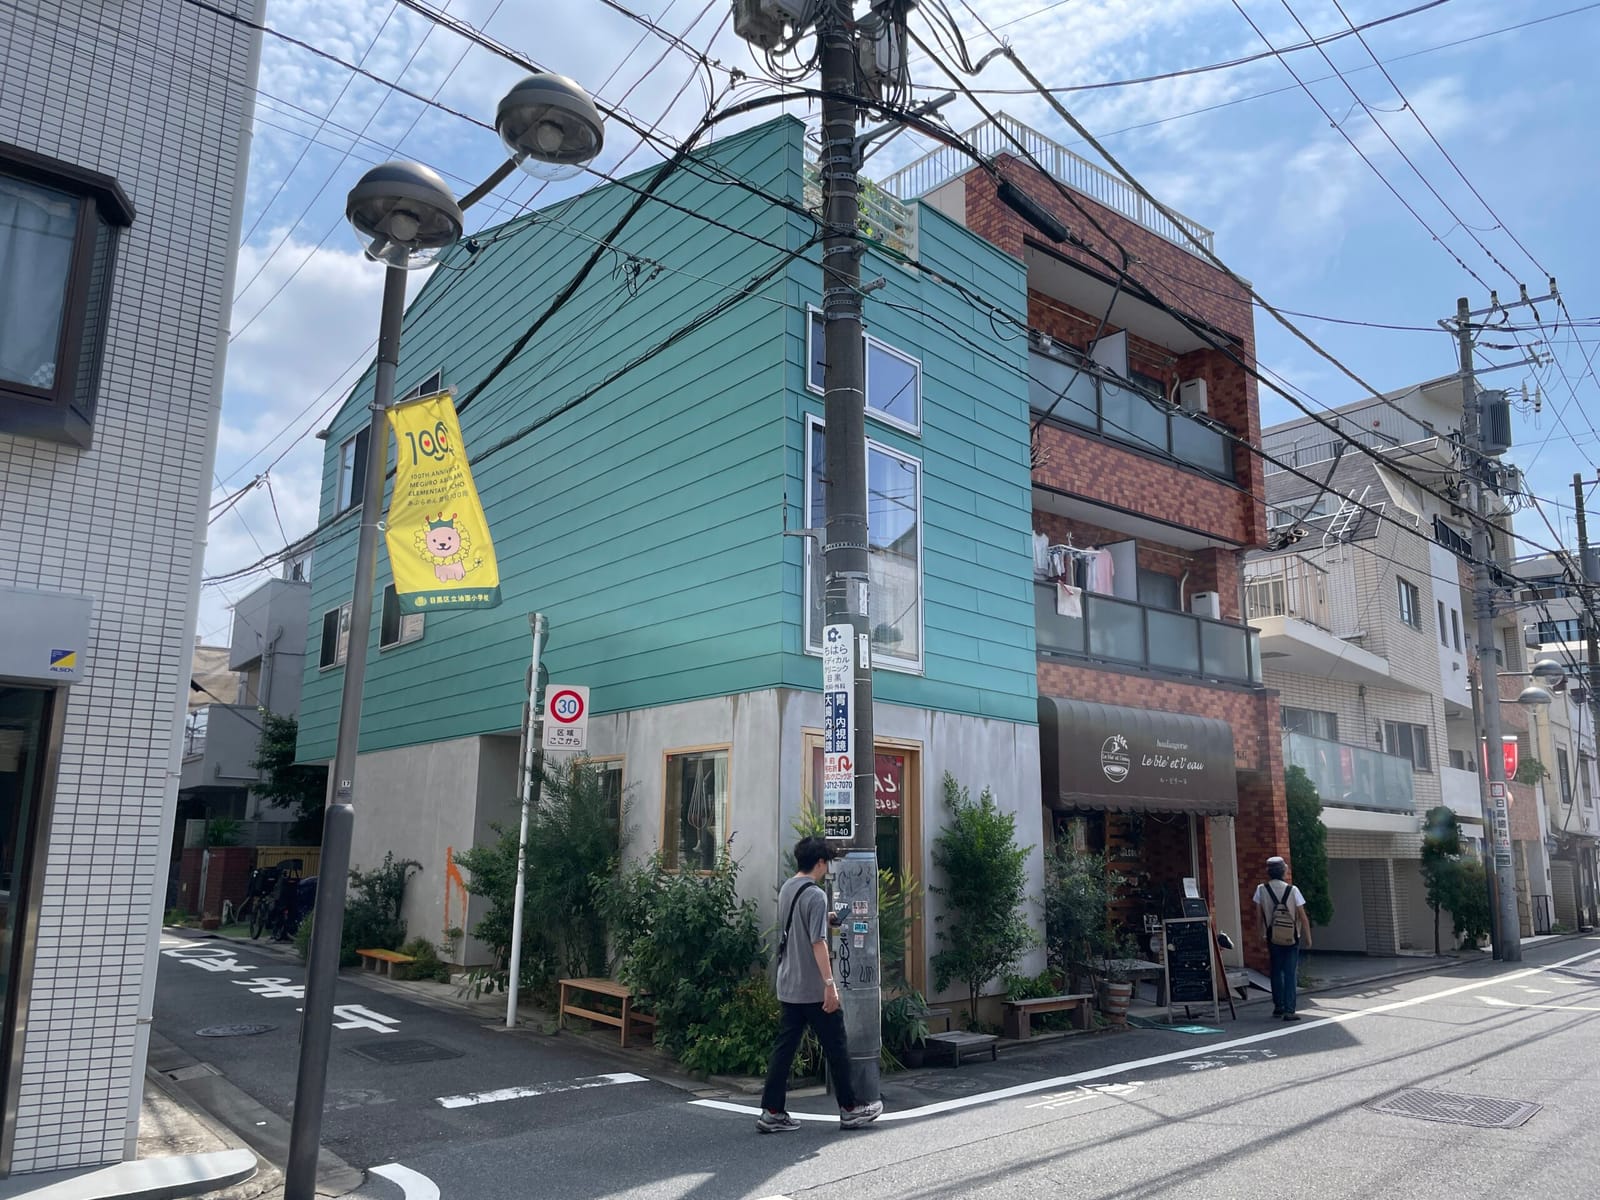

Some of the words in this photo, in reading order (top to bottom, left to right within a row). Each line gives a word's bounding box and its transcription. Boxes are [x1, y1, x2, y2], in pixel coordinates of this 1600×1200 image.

[409, 479, 438, 489] MEGURO
[557, 699, 577, 714] 30
[549, 737, 580, 746] ここから
[1141, 754, 1153, 767] Le
[1169, 757, 1180, 769] et
